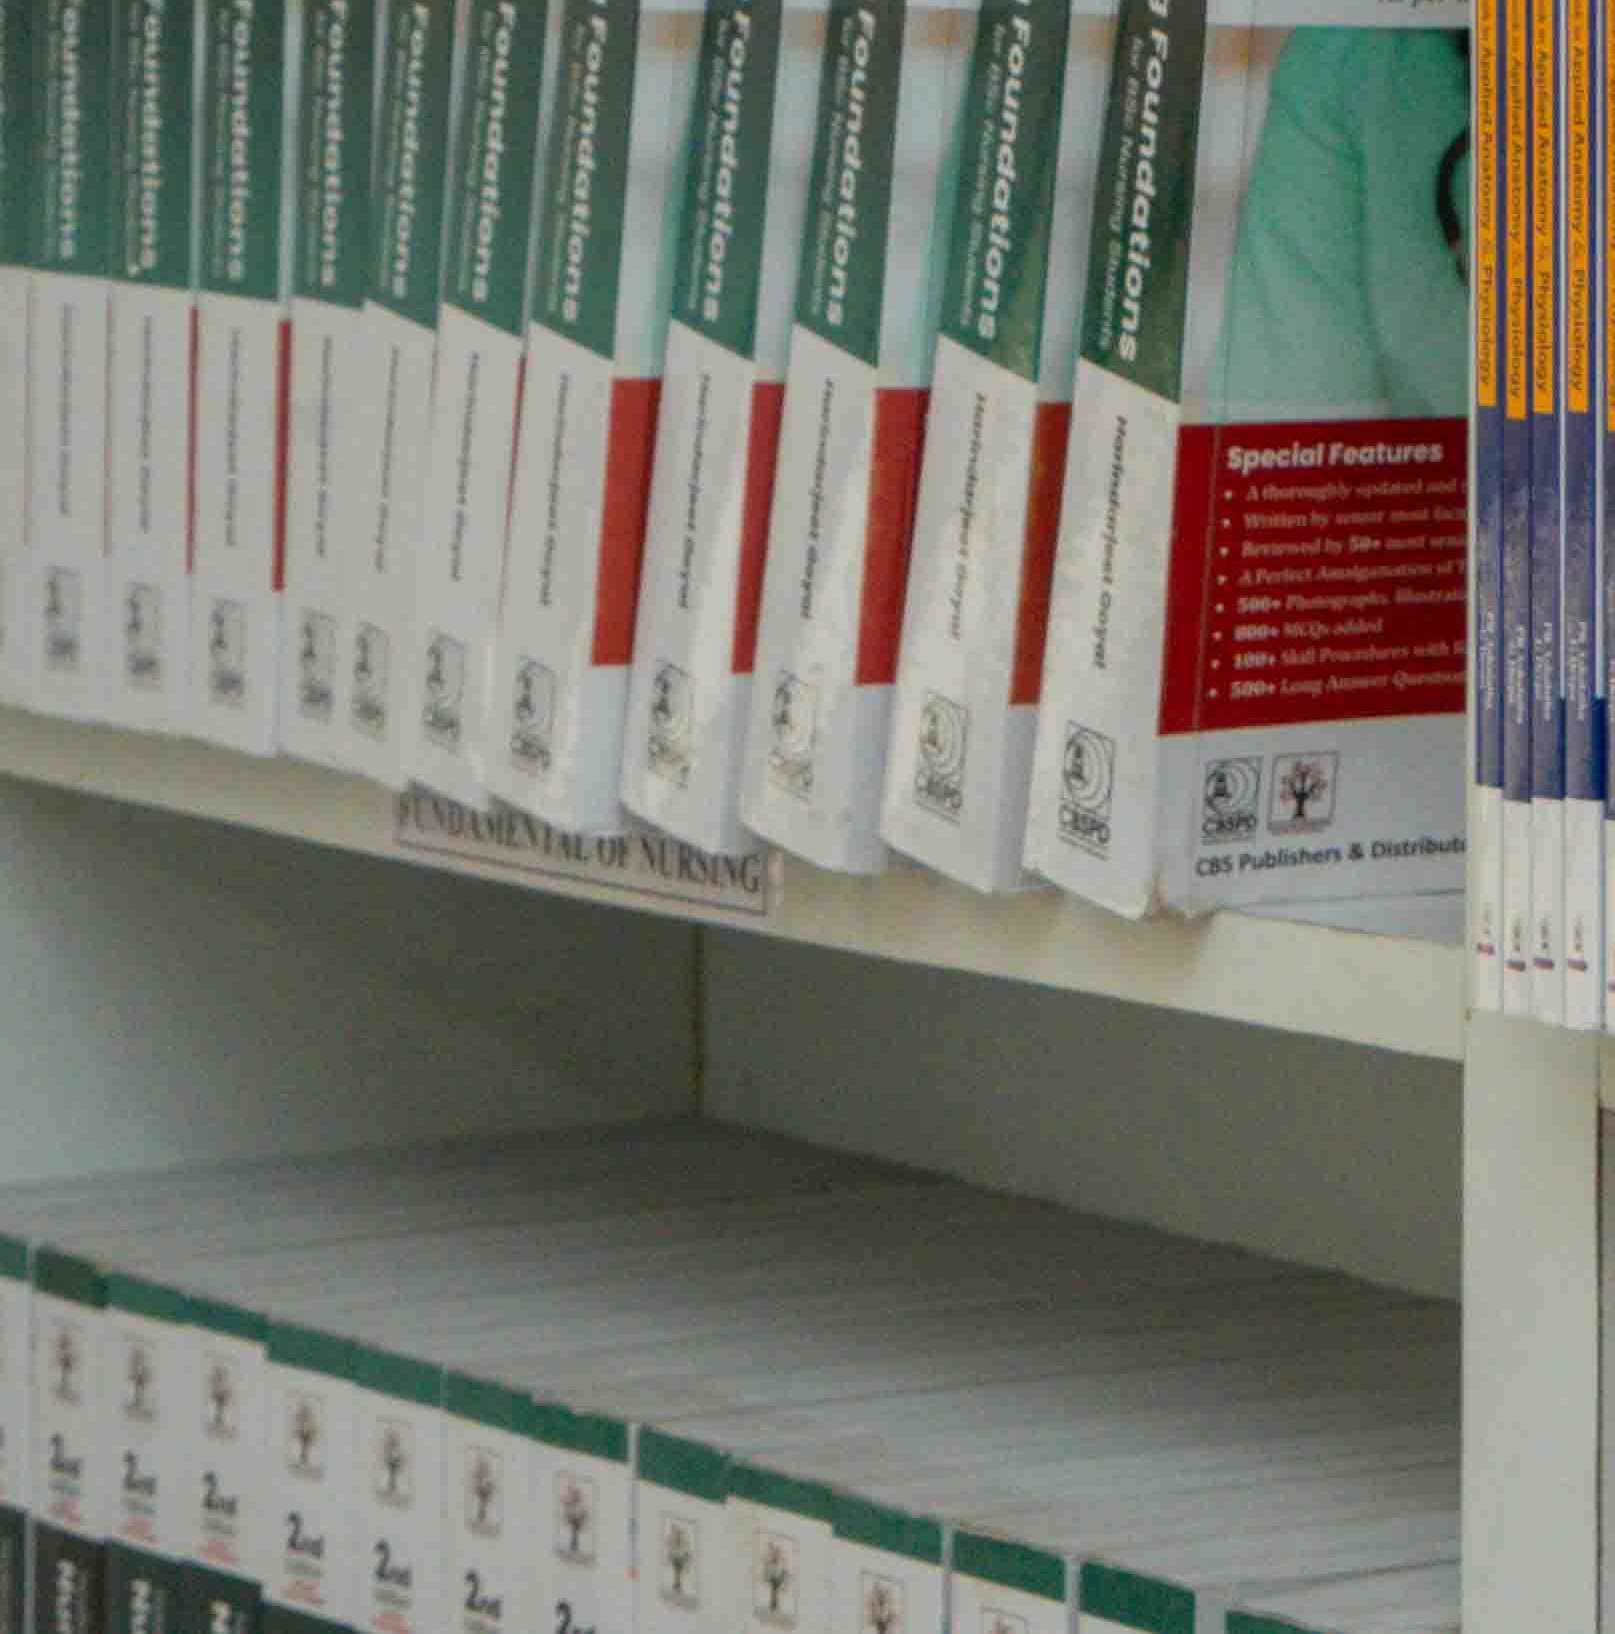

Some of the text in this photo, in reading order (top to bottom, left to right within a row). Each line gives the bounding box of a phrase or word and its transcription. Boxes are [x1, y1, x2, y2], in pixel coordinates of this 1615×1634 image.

[978, 16, 1031, 339] Foundations
[1120, 29, 1169, 361] Foundations
[1227, 442, 1444, 477] Special Features
[1195, 857, 1232, 877] CBS
[1239, 846, 1342, 871] Publishers
[1347, 843, 1364, 860] &
